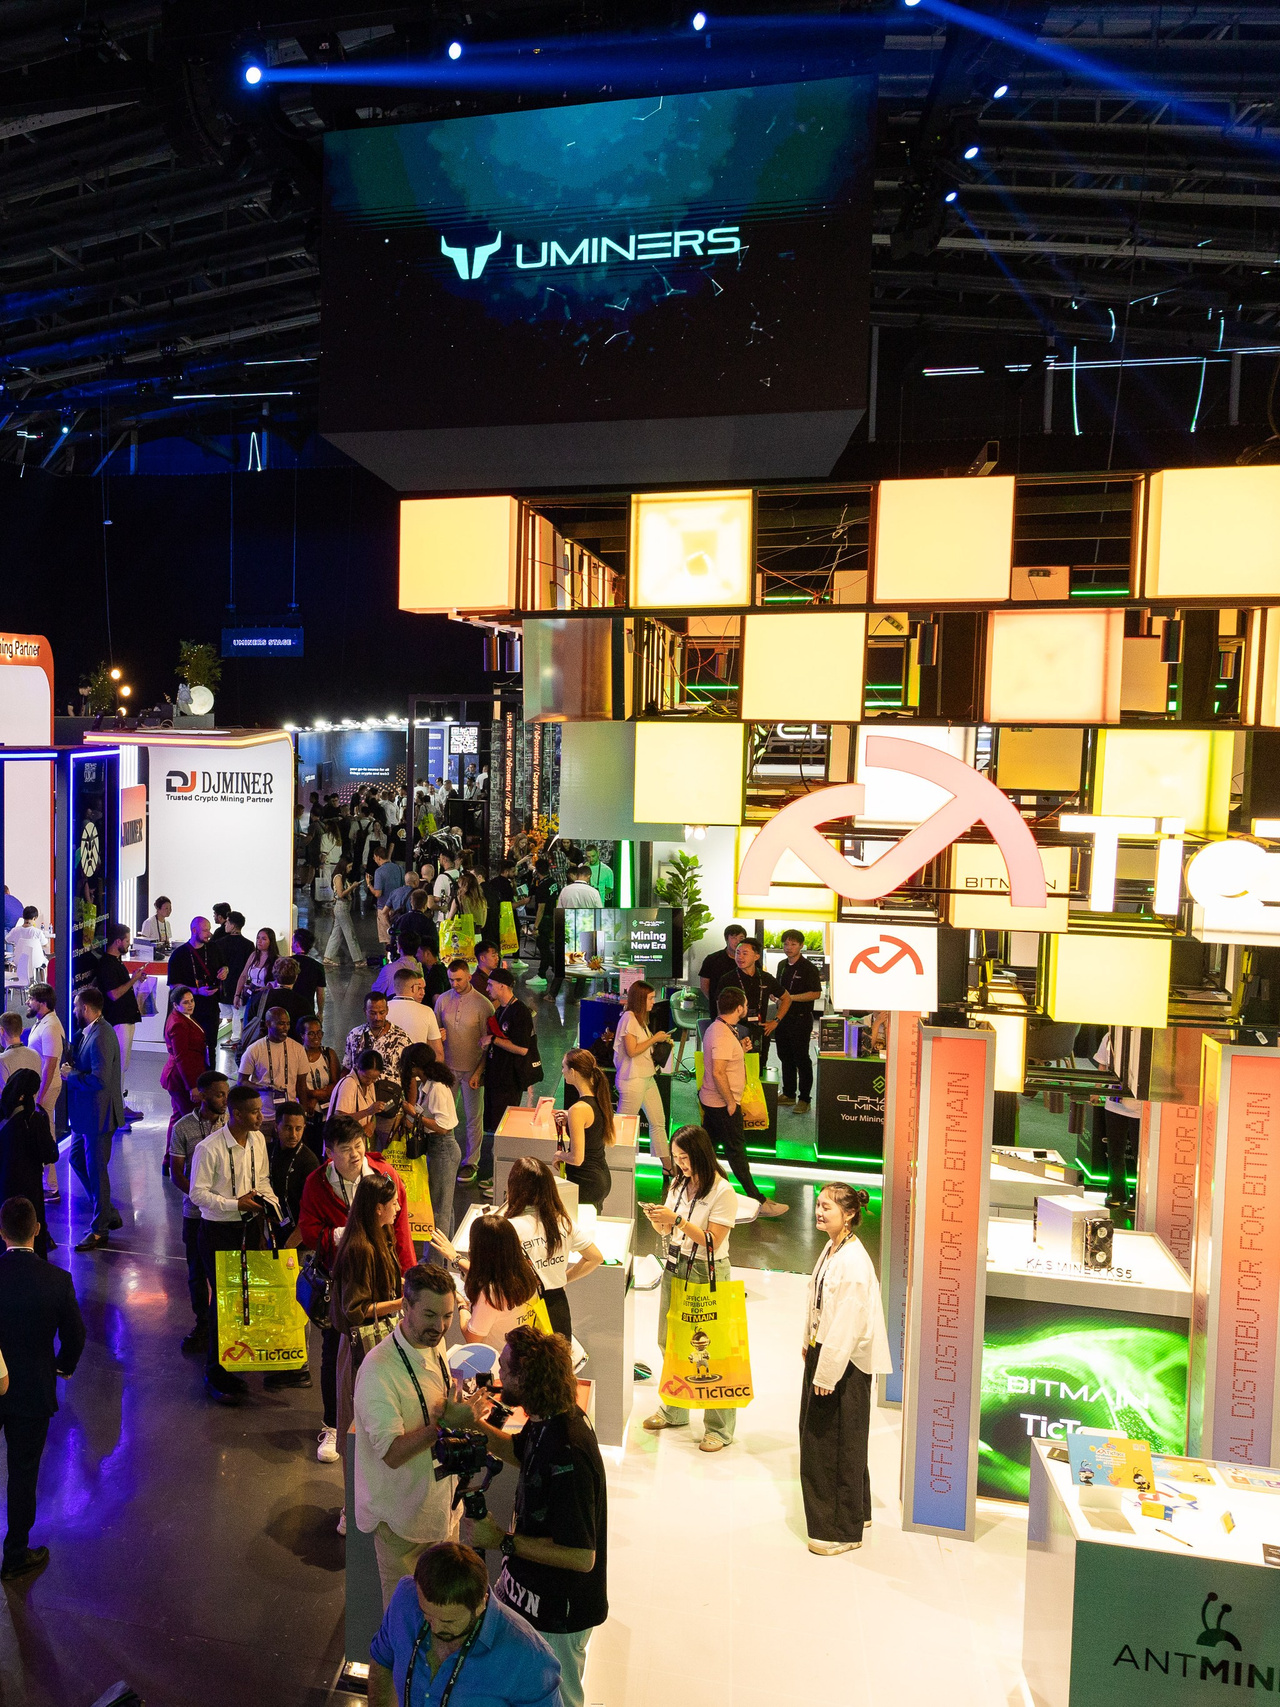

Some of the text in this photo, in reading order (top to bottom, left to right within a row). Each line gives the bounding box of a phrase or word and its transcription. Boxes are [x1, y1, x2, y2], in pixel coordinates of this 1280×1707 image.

[516, 226, 740, 269] UMINERS
[14, 640, 40, 656] Partner
[202, 771, 273, 794] DJMINER
[194, 795, 218, 803] Crypto
[220, 795, 244, 803] Mining
[631, 931, 666, 942] Mining
[840, 1113, 858, 1121] Your
[1174, 1126, 1196, 1166] FOR
[1242, 1091, 1271, 1196] BITMAIN
[1240, 1204, 1265, 1251] FOR
[536, 1255, 565, 1269] TicTacc
[1026, 1257, 1052, 1271] KAS
[1106, 1266, 1133, 1280] KS5
[930, 1071, 970, 1494] OFFICIAL DISTRIBUTOR FOR BITMAIN
[682, 1312, 715, 1322] BITMAIN
[1231, 1259, 1262, 1419] DISTRIBUTOR
[256, 1349, 304, 1361] TicTacc
[695, 1386, 751, 1399] TicTacc
[1007, 1376, 1149, 1410] BITMAIN
